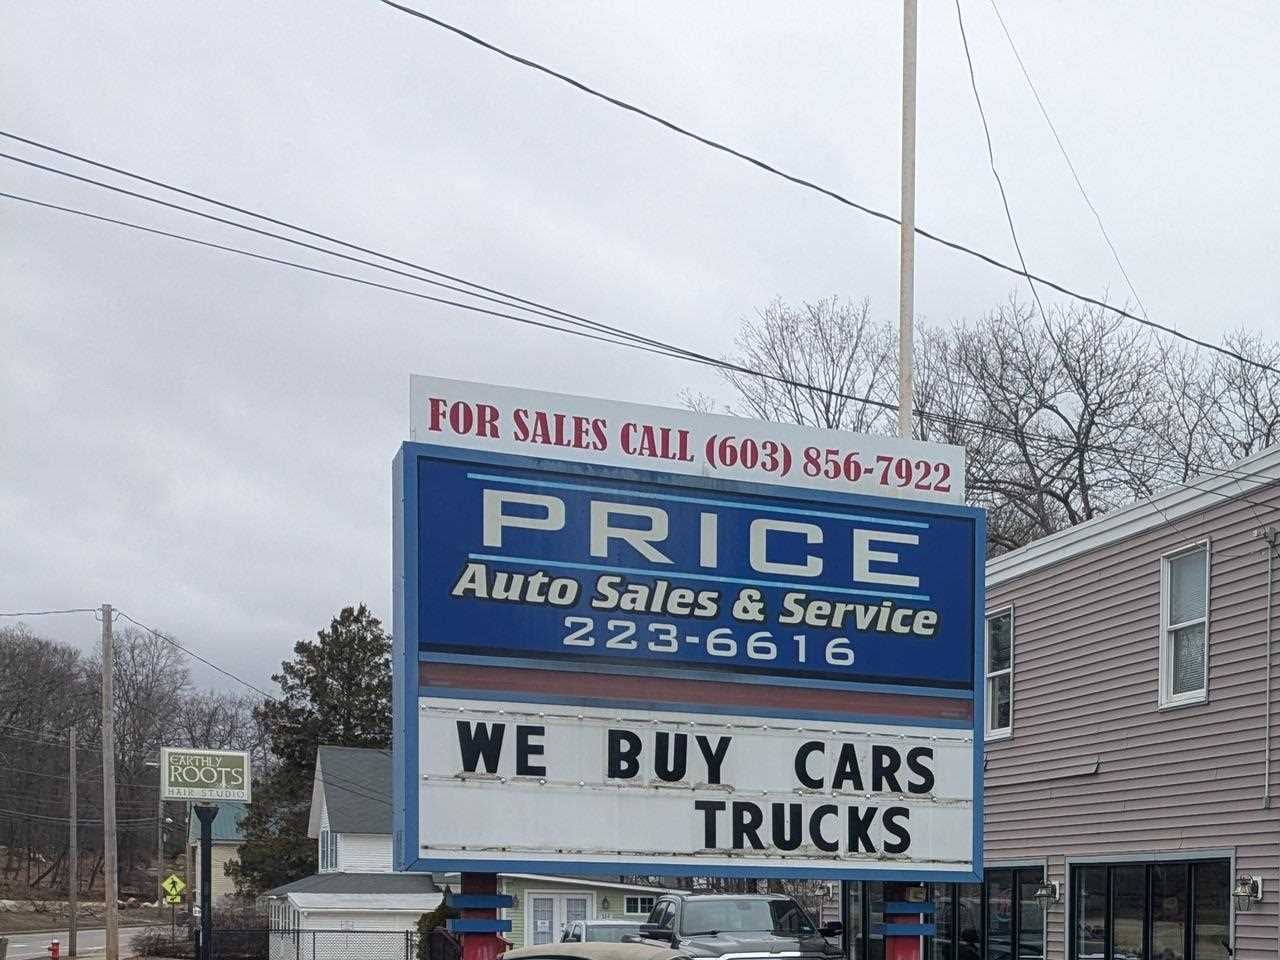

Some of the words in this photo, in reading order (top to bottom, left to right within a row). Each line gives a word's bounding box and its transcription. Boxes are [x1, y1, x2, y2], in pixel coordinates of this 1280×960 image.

[428, 397, 500, 439] FOR
[513, 408, 608, 451] SALES
[620, 422, 694, 462] CALL
[705, 434, 792, 478] (603)
[803, 446, 951, 493] 856-7922
[482, 488, 920, 588] PRICE
[452, 563, 579, 605] Auto
[592, 575, 719, 617] Sales
[732, 588, 766, 622] &
[779, 592, 938, 636] Service
[563, 616, 855, 666] 223-6616
[169, 755, 222, 767] EARTHLY
[170, 765, 243, 787] ROOTS
[456, 720, 546, 776] WE
[608, 730, 732, 785] BUY
[794, 741, 935, 794] CARS
[168, 788, 194, 797] HAIR
[201, 789, 245, 798] STUDIO
[694, 801, 911, 854] TRUCKS
